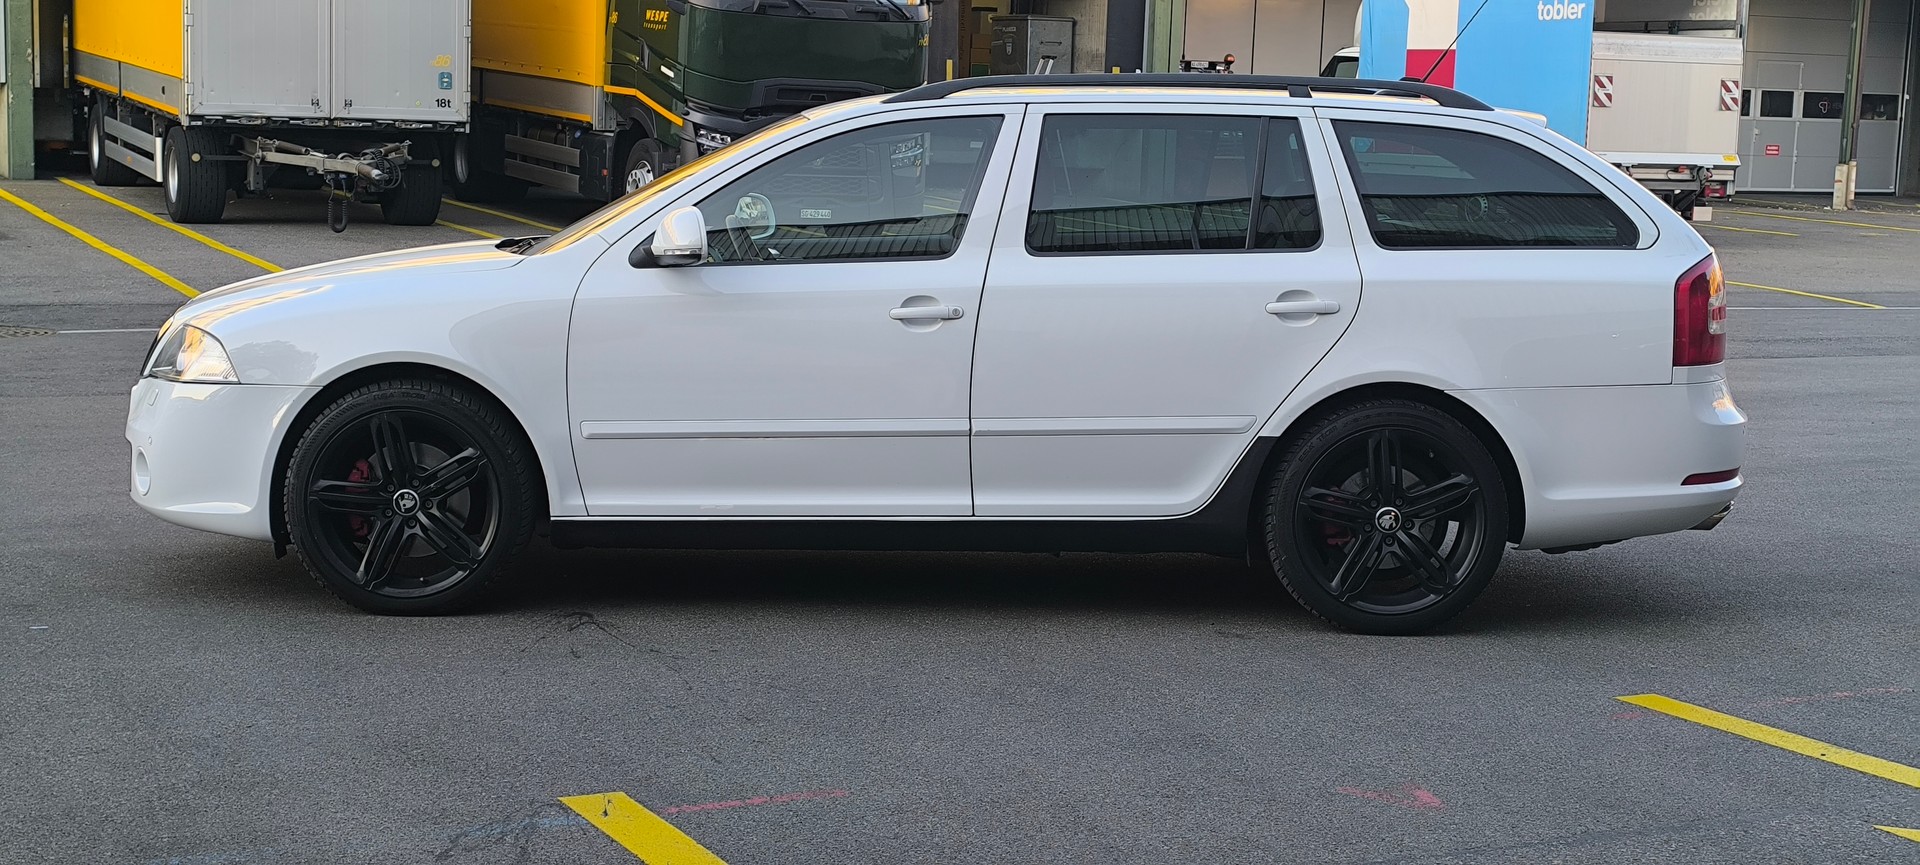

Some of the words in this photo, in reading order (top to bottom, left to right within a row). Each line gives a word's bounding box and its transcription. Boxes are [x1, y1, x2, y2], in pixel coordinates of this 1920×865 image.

[645, 9, 669, 22] WESPE
[1537, 0, 1585, 20] tobler
[643, 22, 667, 30] transport
[435, 98, 452, 108] 18t
